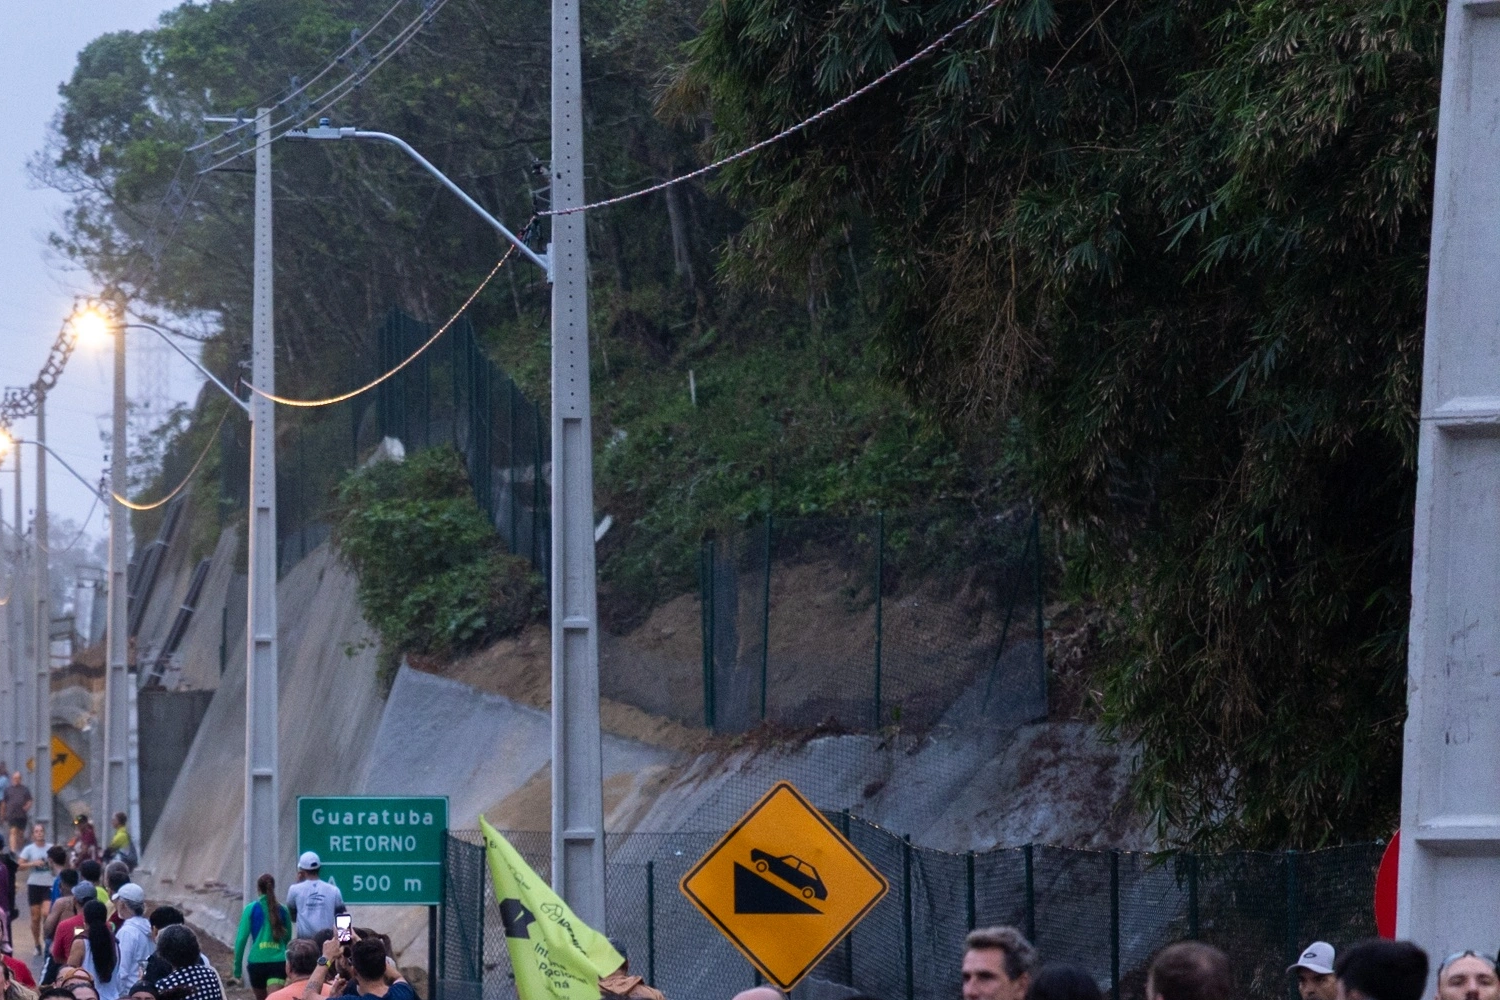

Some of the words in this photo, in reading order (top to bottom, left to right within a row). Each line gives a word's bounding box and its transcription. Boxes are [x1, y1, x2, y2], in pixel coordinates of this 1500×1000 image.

[312, 808, 434, 825] Guaratuba
[329, 836, 417, 851] RETORNO
[352, 875, 391, 891] 500
[404, 878, 422, 891] m
